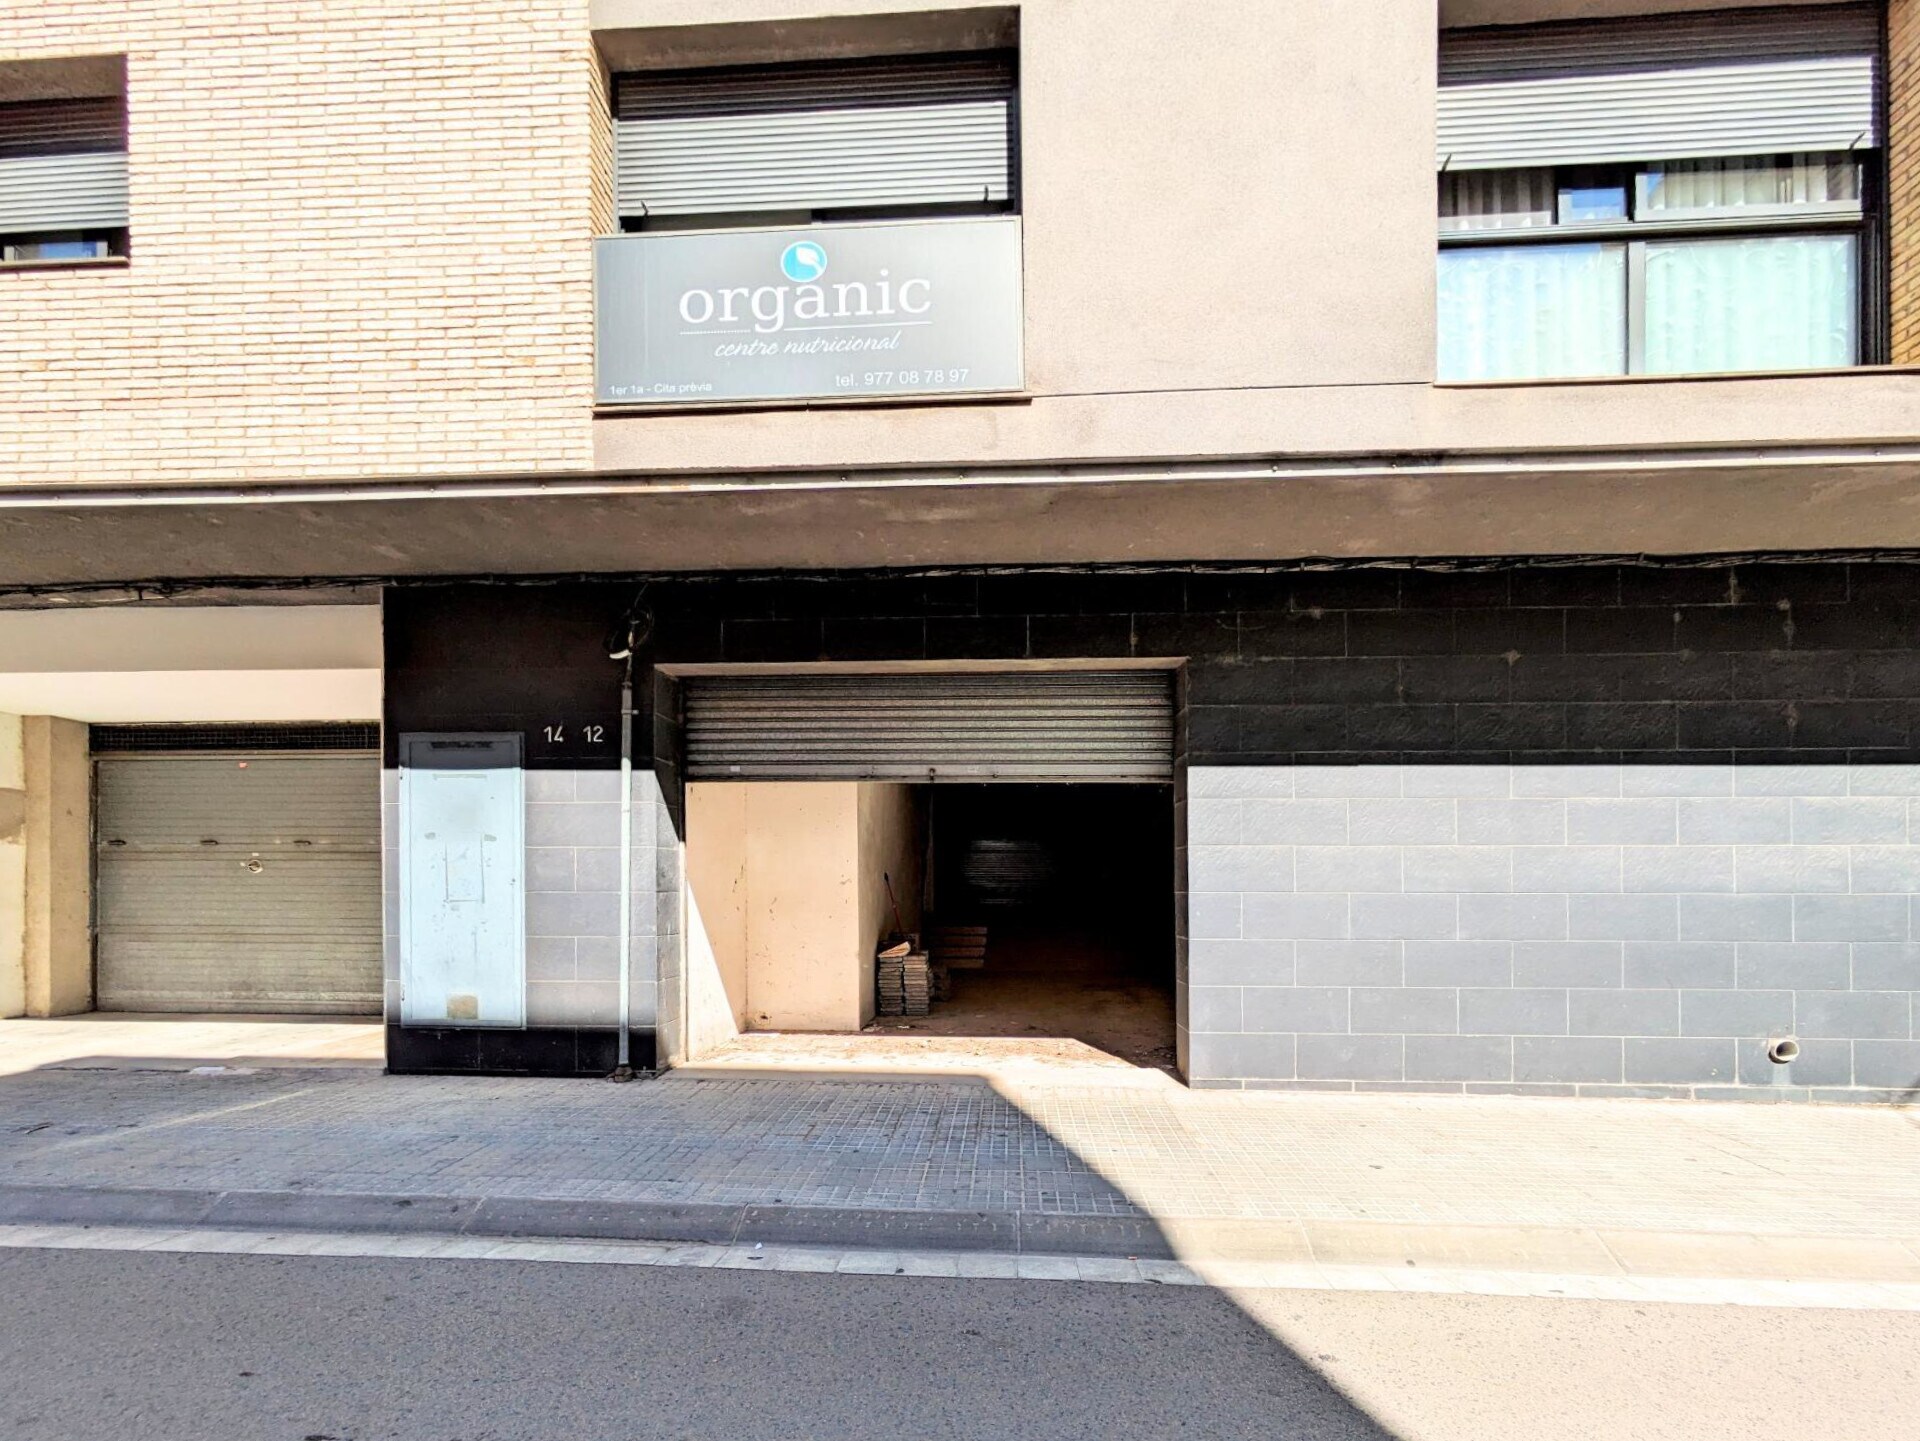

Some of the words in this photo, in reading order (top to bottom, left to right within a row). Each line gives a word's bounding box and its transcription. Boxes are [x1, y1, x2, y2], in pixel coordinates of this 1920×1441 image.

[678, 268, 932, 333] organic
[713, 339, 777, 357] centre
[783, 330, 902, 355] nutricional
[835, 373, 859, 387] tel.
[864, 371, 894, 386] 977
[899, 370, 920, 385] 08
[923, 369, 945, 384] 78
[948, 368, 970, 383] 97
[543, 725, 565, 743] 14
[582, 725, 604, 743] 12
